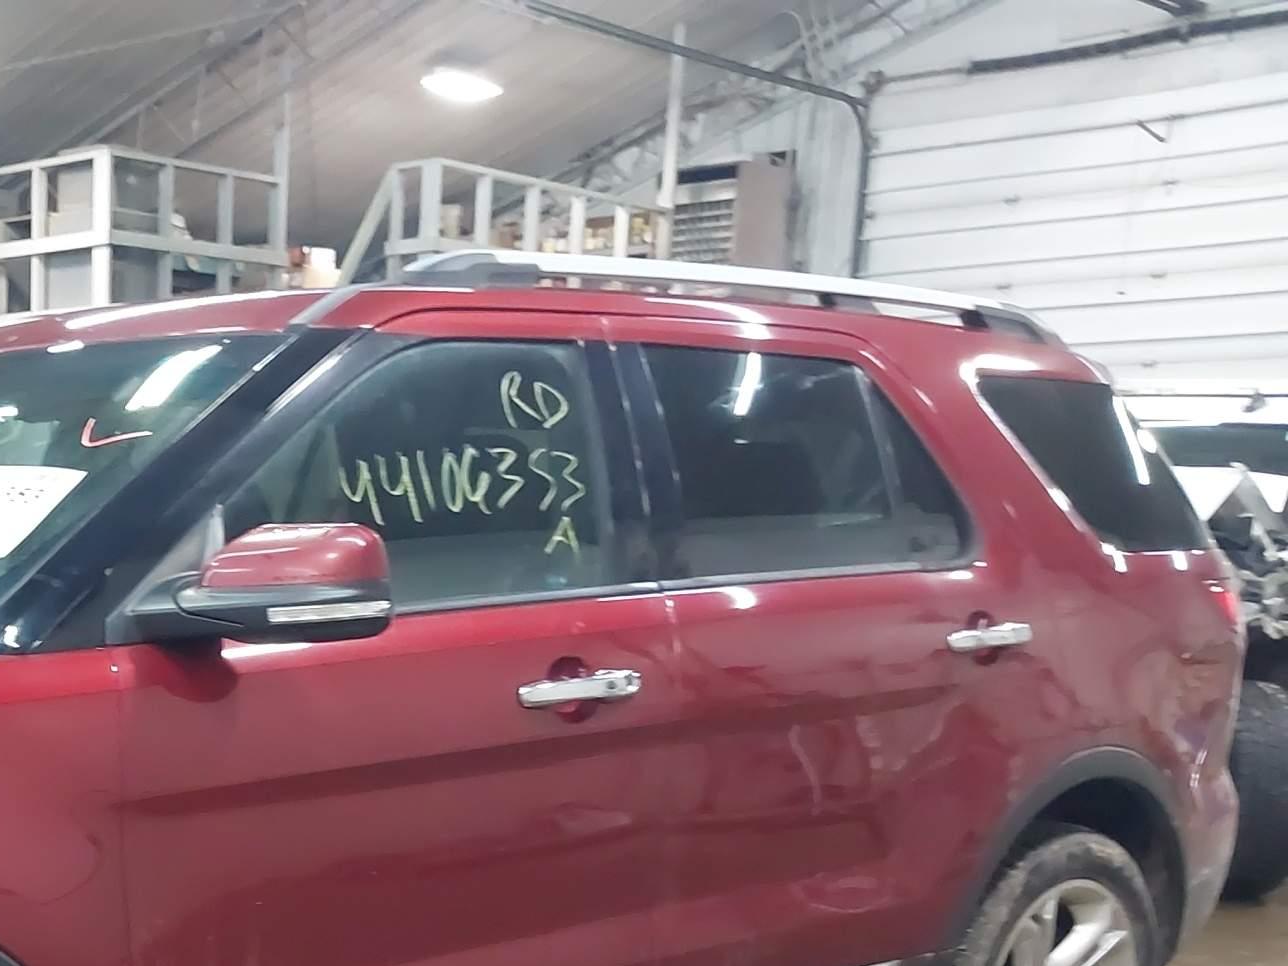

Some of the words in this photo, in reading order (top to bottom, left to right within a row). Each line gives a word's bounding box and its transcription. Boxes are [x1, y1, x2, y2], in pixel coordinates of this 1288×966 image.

[500, 371, 570, 429] RD
[338, 443, 587, 527] 44106353
[543, 515, 581, 563] A
